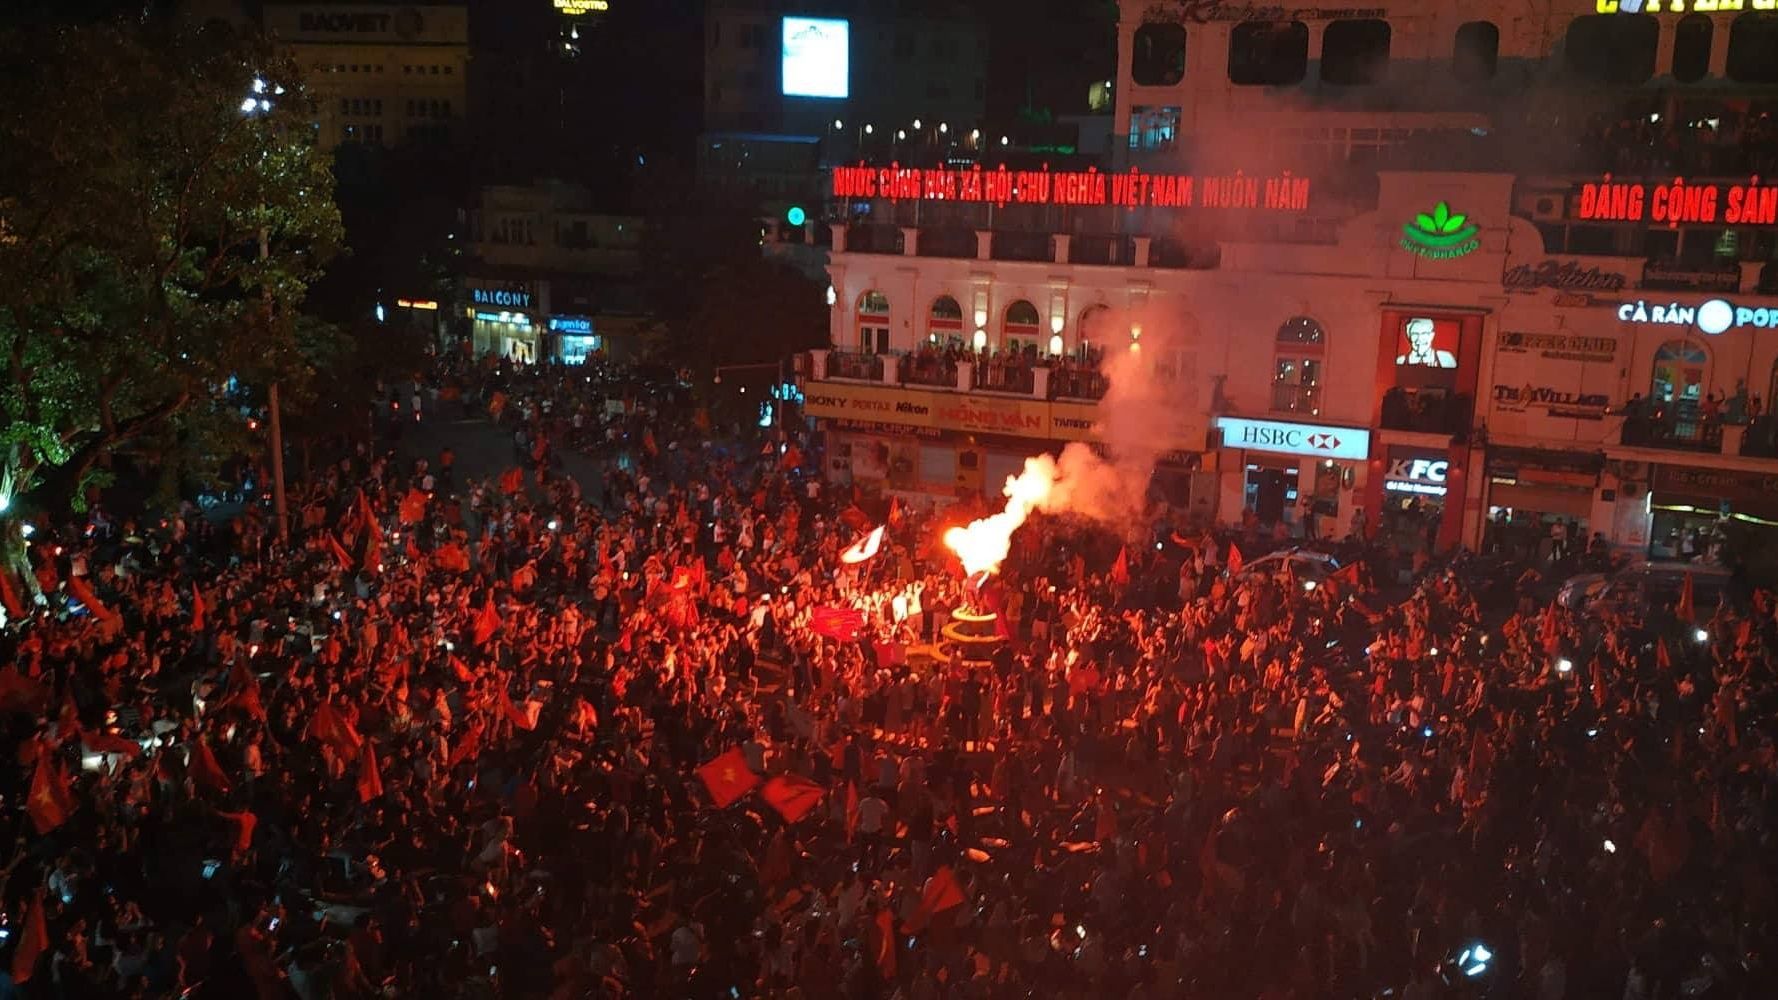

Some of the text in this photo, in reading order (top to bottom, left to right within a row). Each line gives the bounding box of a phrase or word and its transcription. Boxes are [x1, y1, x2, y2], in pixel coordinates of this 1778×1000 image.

[879, 161, 921, 204] CỘNG
[985, 163, 1011, 208] HỘI
[1112, 166, 1151, 211] VIỆT
[1151, 174, 1194, 208] NAM
[1202, 170, 1259, 210] MUÔN
[1264, 170, 1310, 210] NĂM
[1579, 172, 1778, 230] ĐẢNG CỘNG SẢN
[475, 289, 530, 307] BALCONY
[1652, 303, 1694, 324] RÁN
[806, 395, 848, 409] SONY
[896, 401, 929, 416] Nikon
[1242, 426, 1302, 448] HSBC
[1387, 458, 1449, 482] KFC
